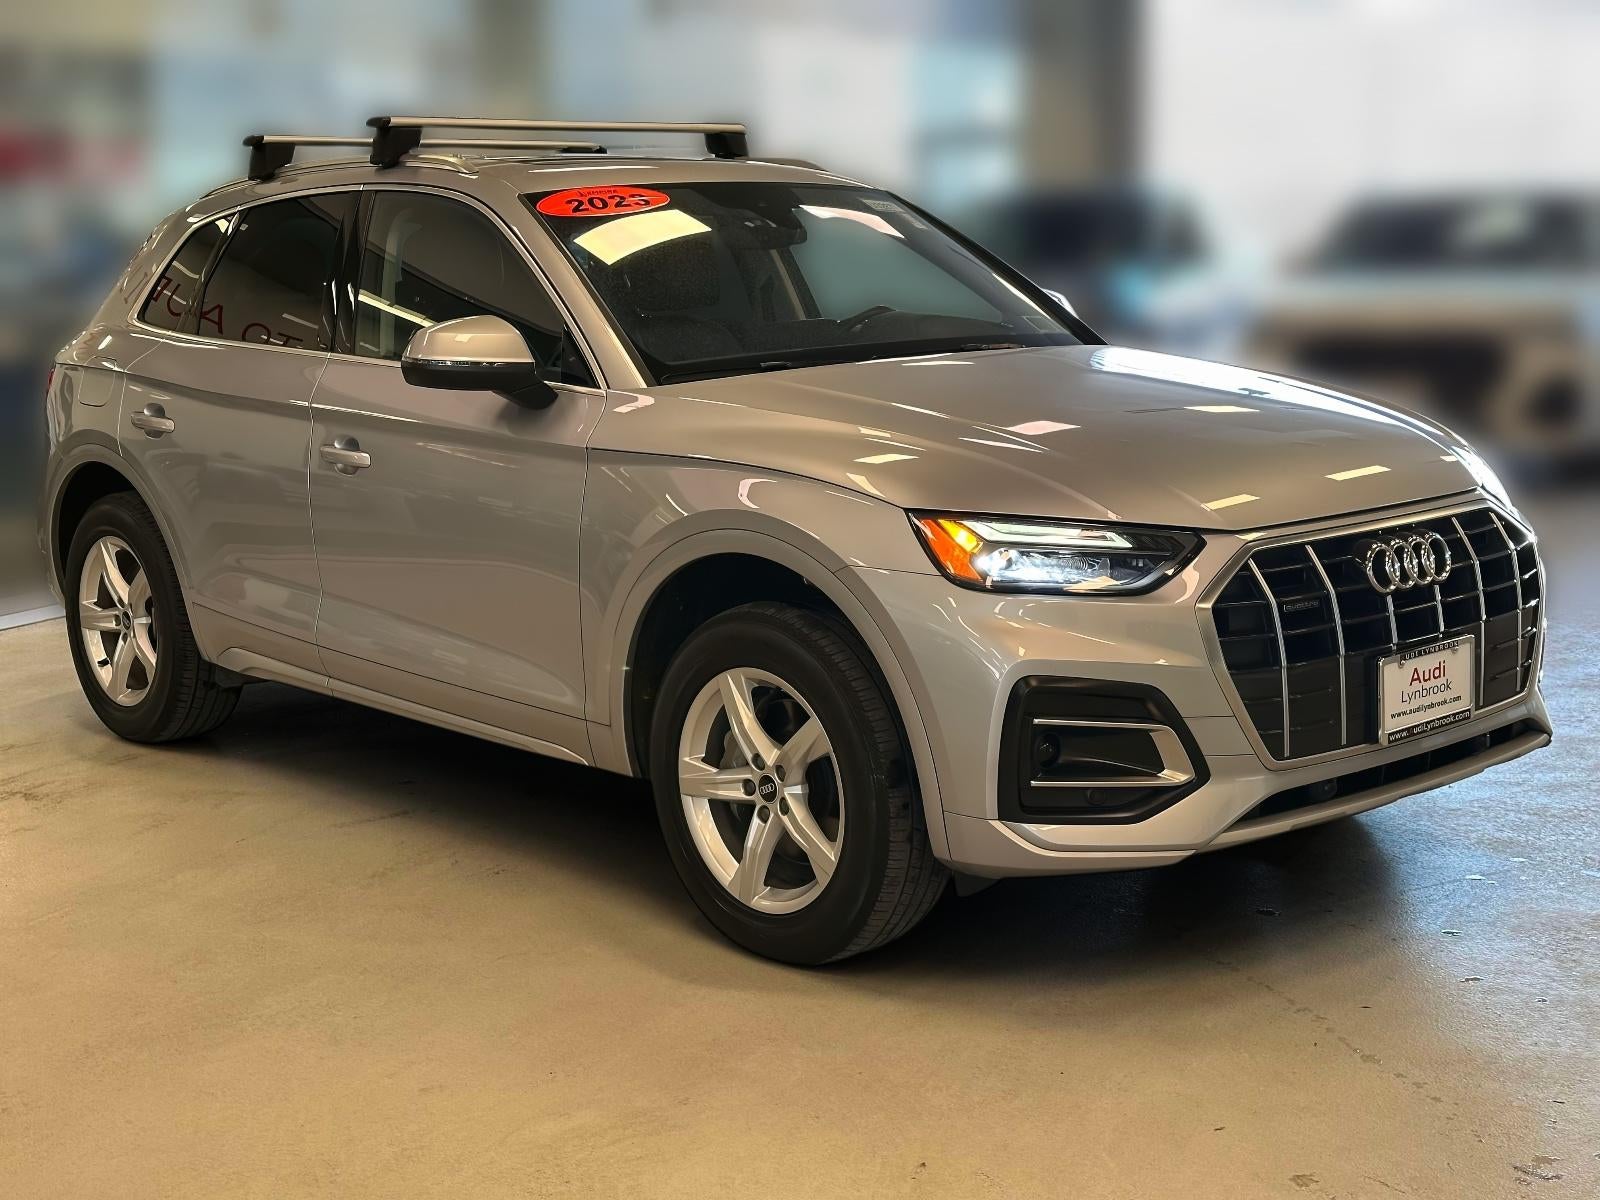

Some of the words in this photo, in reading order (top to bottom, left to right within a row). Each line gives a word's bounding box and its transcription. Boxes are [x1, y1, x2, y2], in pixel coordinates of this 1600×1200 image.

[565, 193, 650, 213] 2023
[1409, 660, 1446, 686] Audi
[1401, 679, 1452, 704] Lynbrook
[1390, 695, 1462, 719] www.audilynbrook.com
